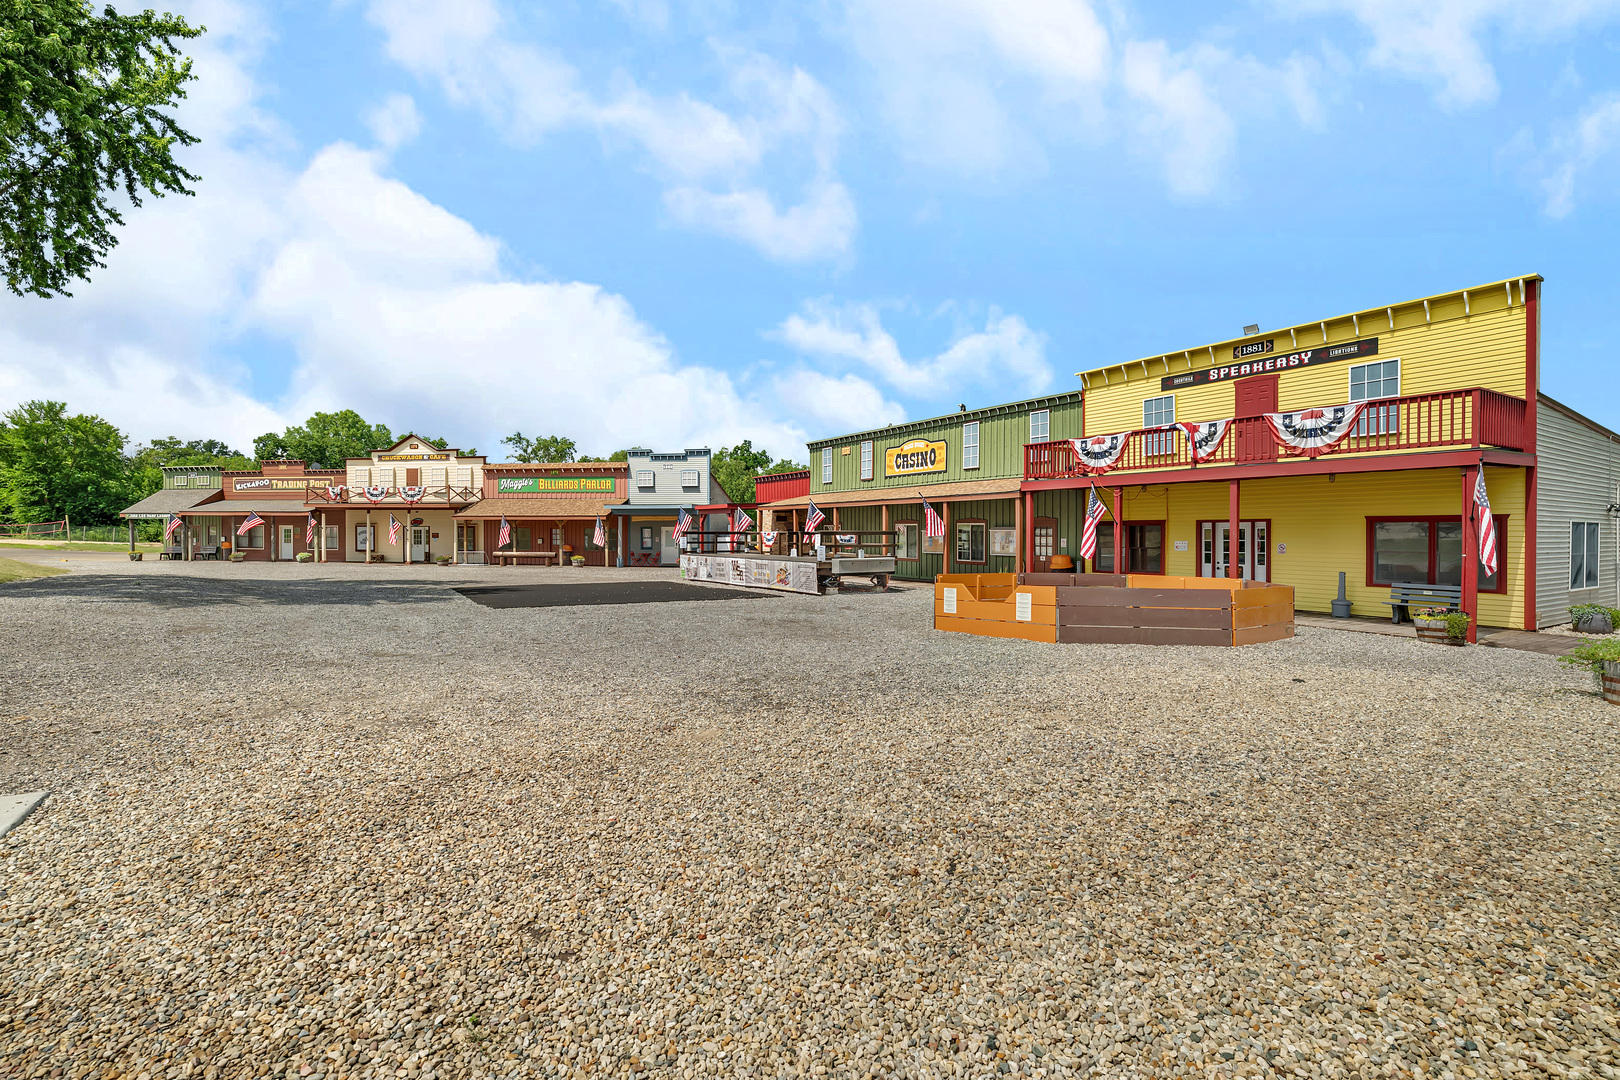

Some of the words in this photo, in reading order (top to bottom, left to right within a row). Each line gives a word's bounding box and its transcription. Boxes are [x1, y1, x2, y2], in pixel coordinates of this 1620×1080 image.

[1242, 344, 1262, 355] 1881
[1208, 351, 1312, 381] SPEAKEASY
[894, 447, 937, 472] CASINO
[235, 479, 270, 490] KICKAPOO
[271, 480, 307, 489] TRADING
[309, 479, 330, 489] POST
[500, 478, 533, 491] Maggie's
[538, 479, 579, 490] BILLIARDS
[579, 479, 611, 490] PARLOR
